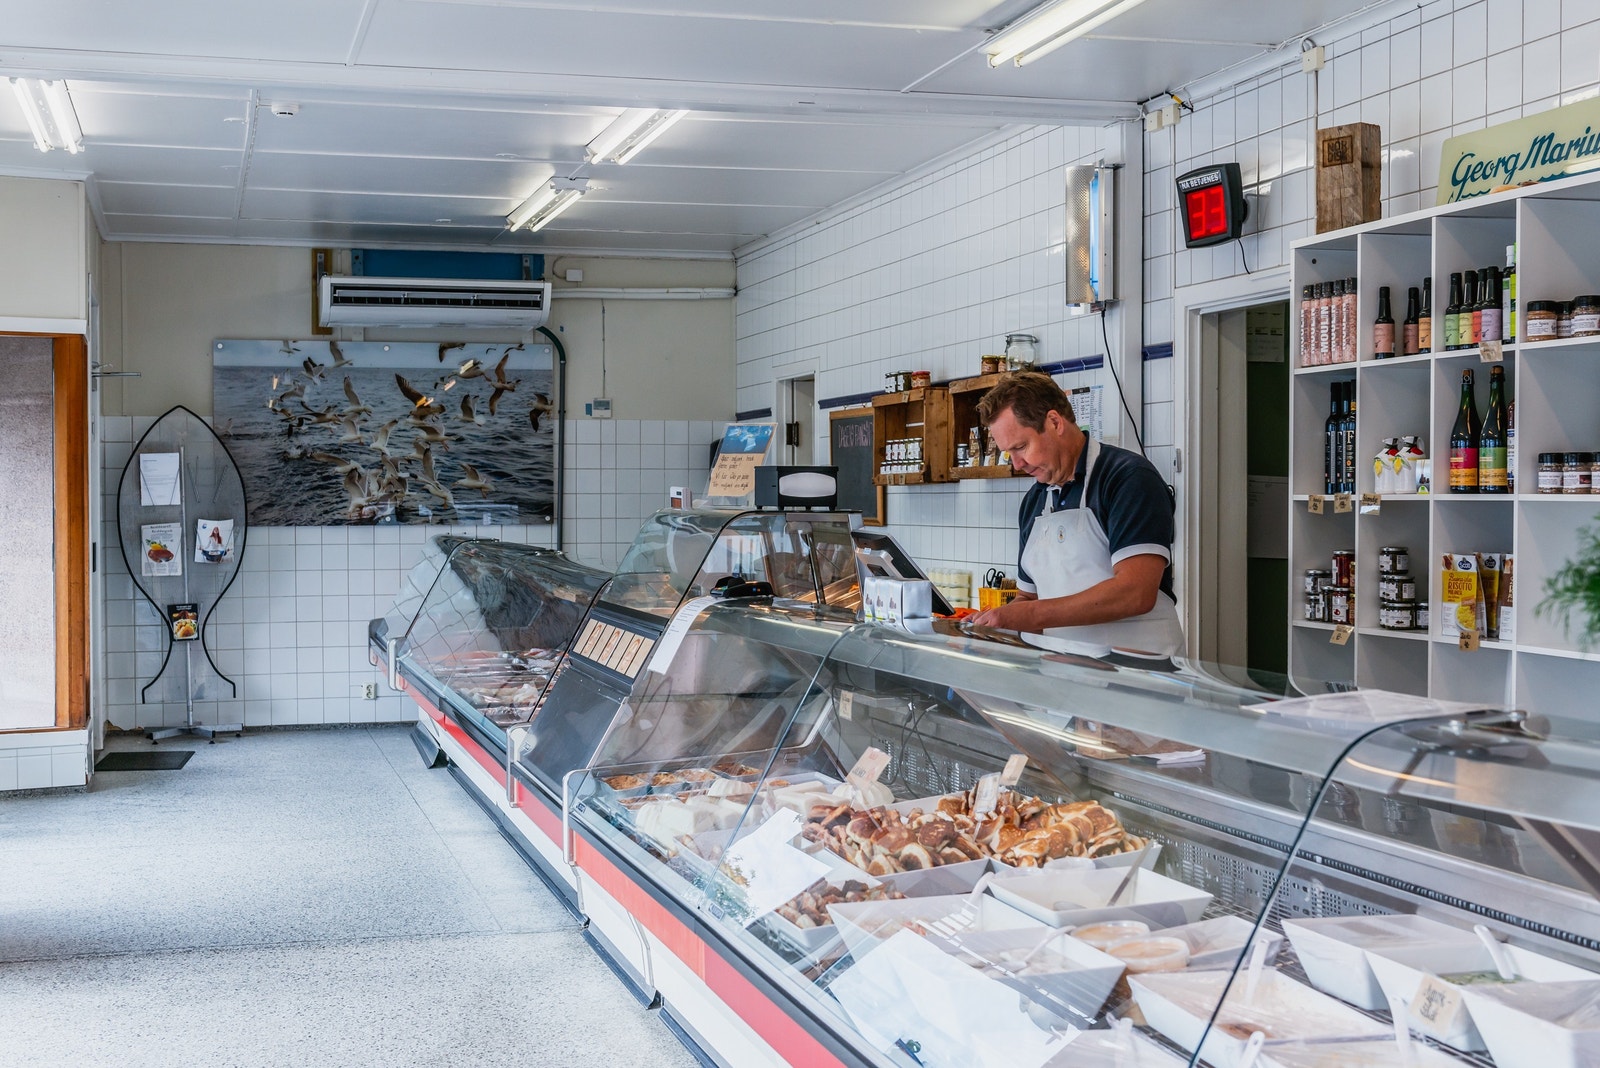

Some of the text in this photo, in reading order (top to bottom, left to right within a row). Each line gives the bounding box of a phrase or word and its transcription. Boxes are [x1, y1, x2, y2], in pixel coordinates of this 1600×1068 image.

[1190, 174, 1219, 187] BETJENES
[1451, 126, 1600, 202] Georg Mariu
[1191, 187, 1224, 238] 33
[1320, 306, 1329, 353] MOULIN
[1448, 581, 1473, 591] RISOTTO
